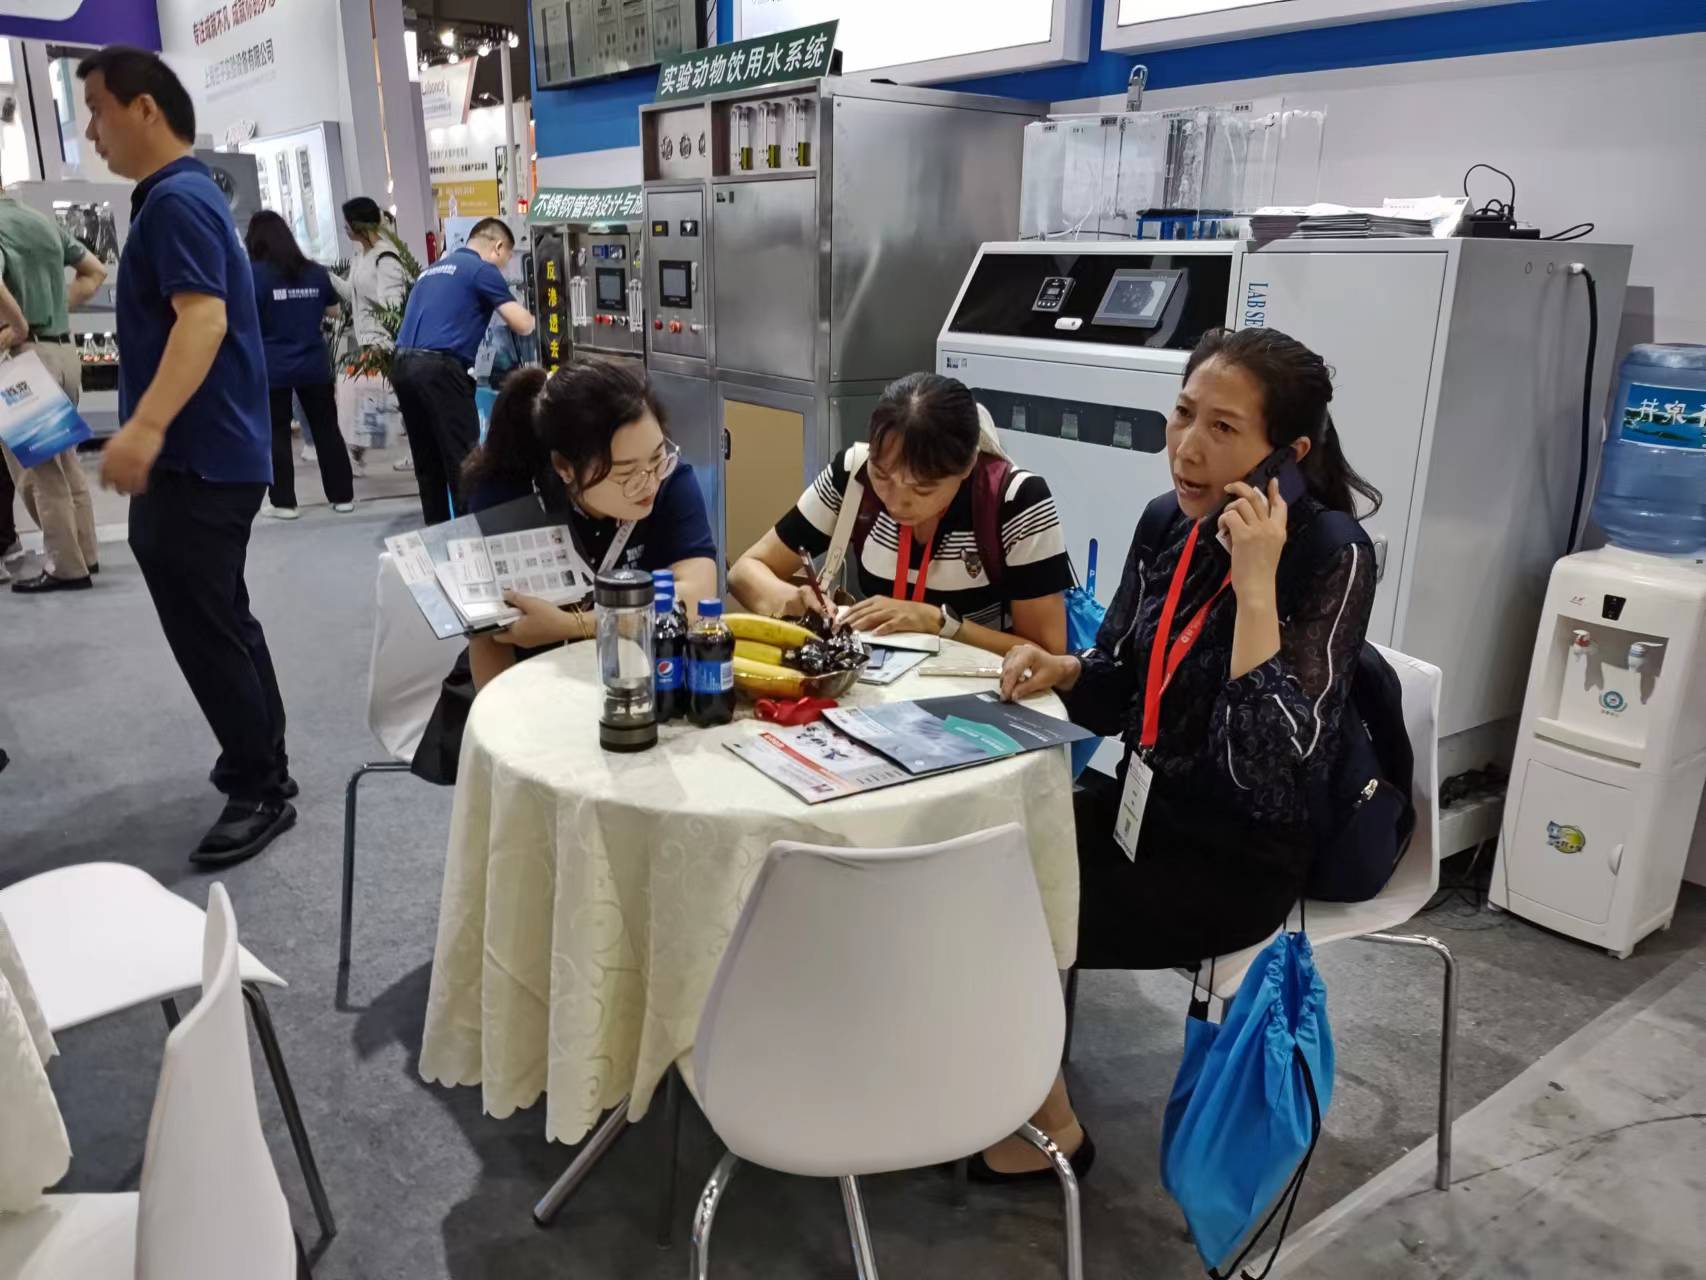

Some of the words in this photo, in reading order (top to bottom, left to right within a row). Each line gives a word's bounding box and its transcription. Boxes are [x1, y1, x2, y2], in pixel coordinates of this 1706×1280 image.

[660, 32, 828, 96] 实验动物饮用水系统
[1247, 283, 1269, 308] LAB
